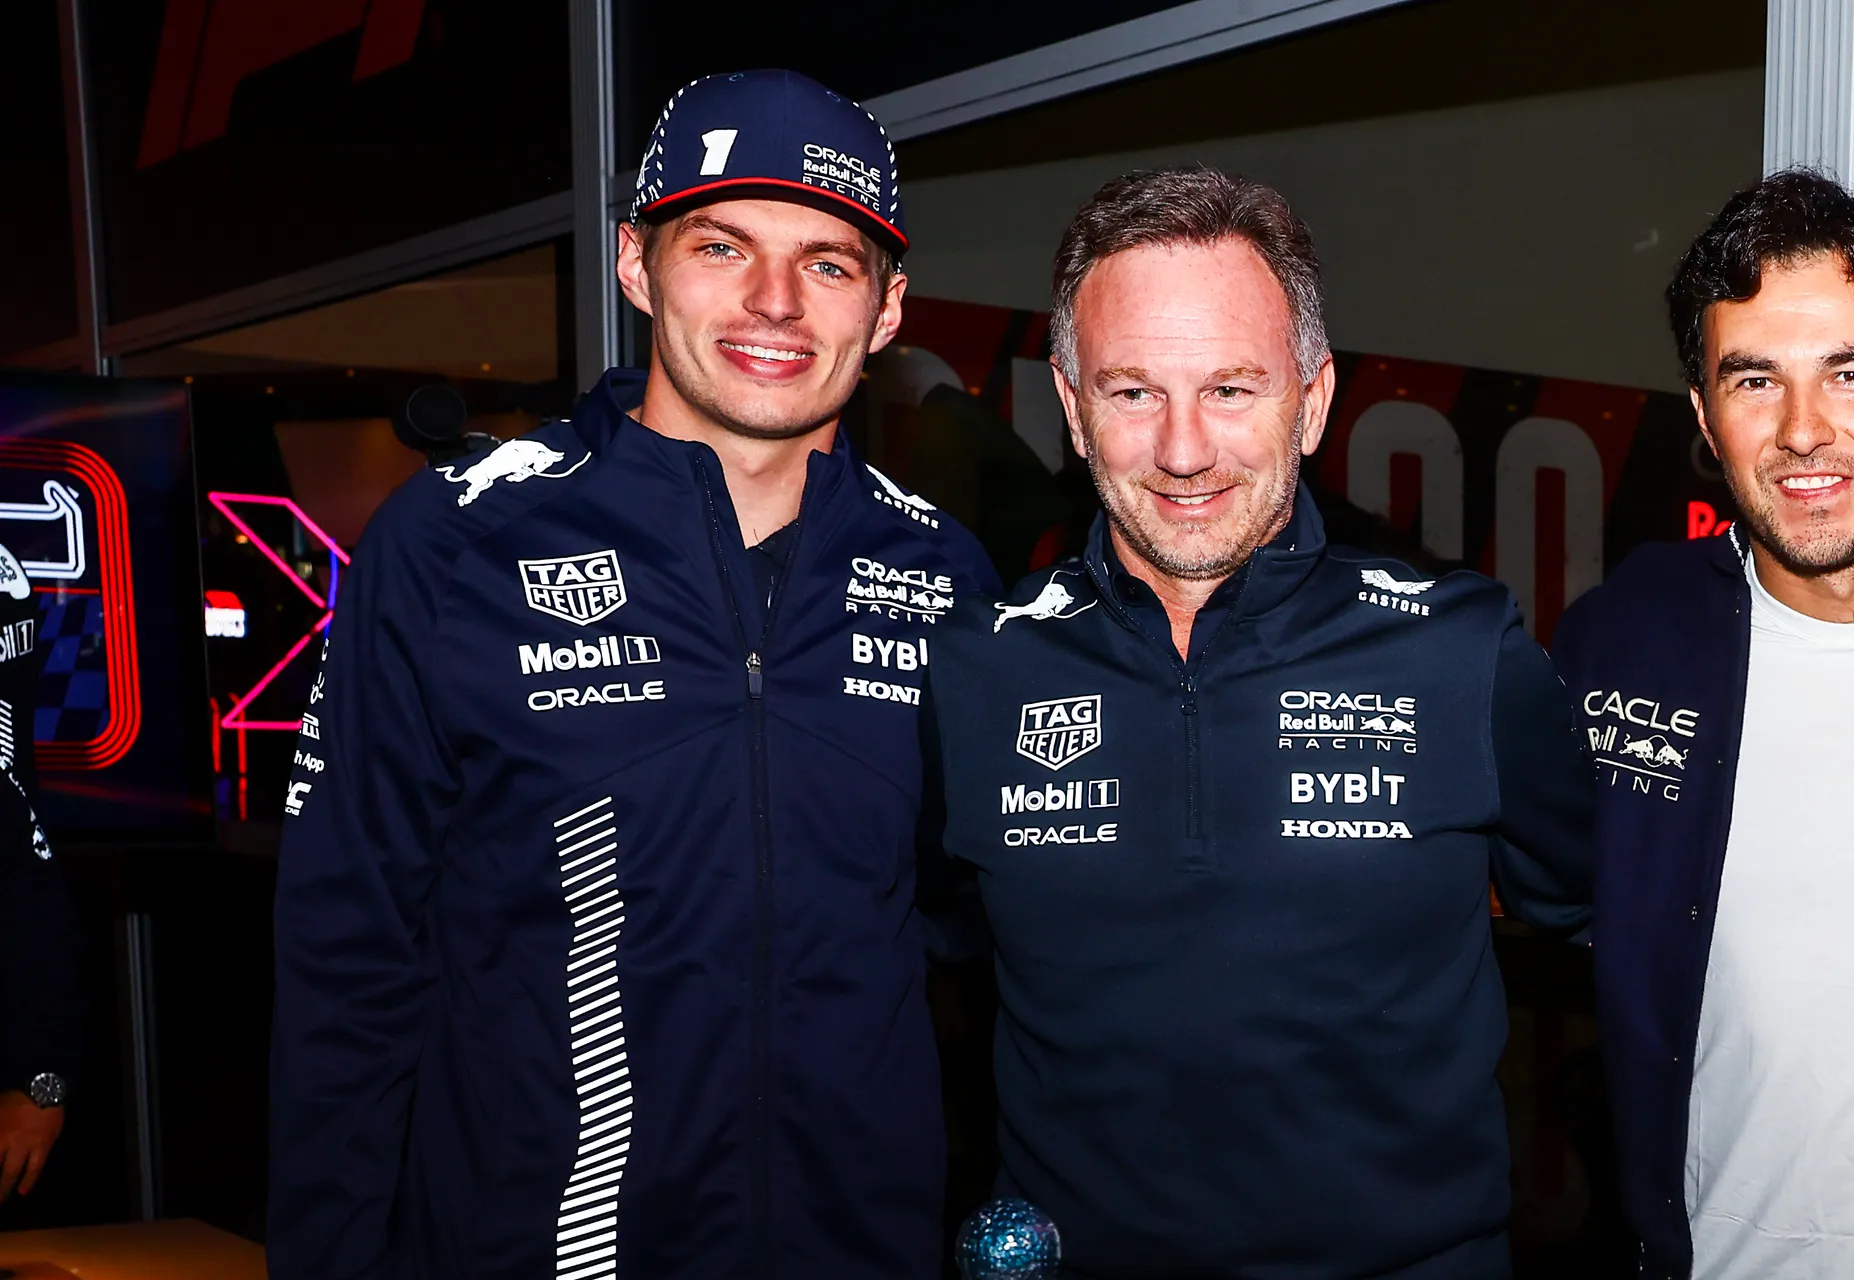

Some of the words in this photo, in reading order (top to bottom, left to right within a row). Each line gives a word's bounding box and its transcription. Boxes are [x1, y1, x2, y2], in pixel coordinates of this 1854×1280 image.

[699, 129, 738, 176] 1
[803, 143, 881, 182] ORACLE
[803, 158, 828, 175] Red
[828, 163, 850, 182] Bull
[803, 176, 880, 212] RACING
[874, 490, 940, 530] CASTORE
[528, 558, 612, 585] TAG
[851, 557, 953, 593] ORACLE
[532, 585, 620, 619] HEUER
[847, 577, 875, 599] Red
[877, 585, 907, 603] Bull
[1358, 591, 1430, 617] CASTORE
[845, 601, 936, 625] RACIN
[518, 635, 621, 675] Mobil
[852, 633, 928, 671] BYBI
[528, 680, 666, 711] ORACLE
[1279, 690, 1416, 715] ORACLE
[1028, 701, 1093, 729] TAG
[1279, 713, 1317, 731] Red
[1319, 713, 1354, 731] Bull
[1022, 729, 1096, 764] HEUER
[1278, 737, 1417, 754] RACING
[1001, 780, 1083, 815] Mobil
[1290, 765, 1405, 805] BYBIT
[1003, 823, 1118, 847] ORACLE
[1280, 819, 1413, 839] HONDA
